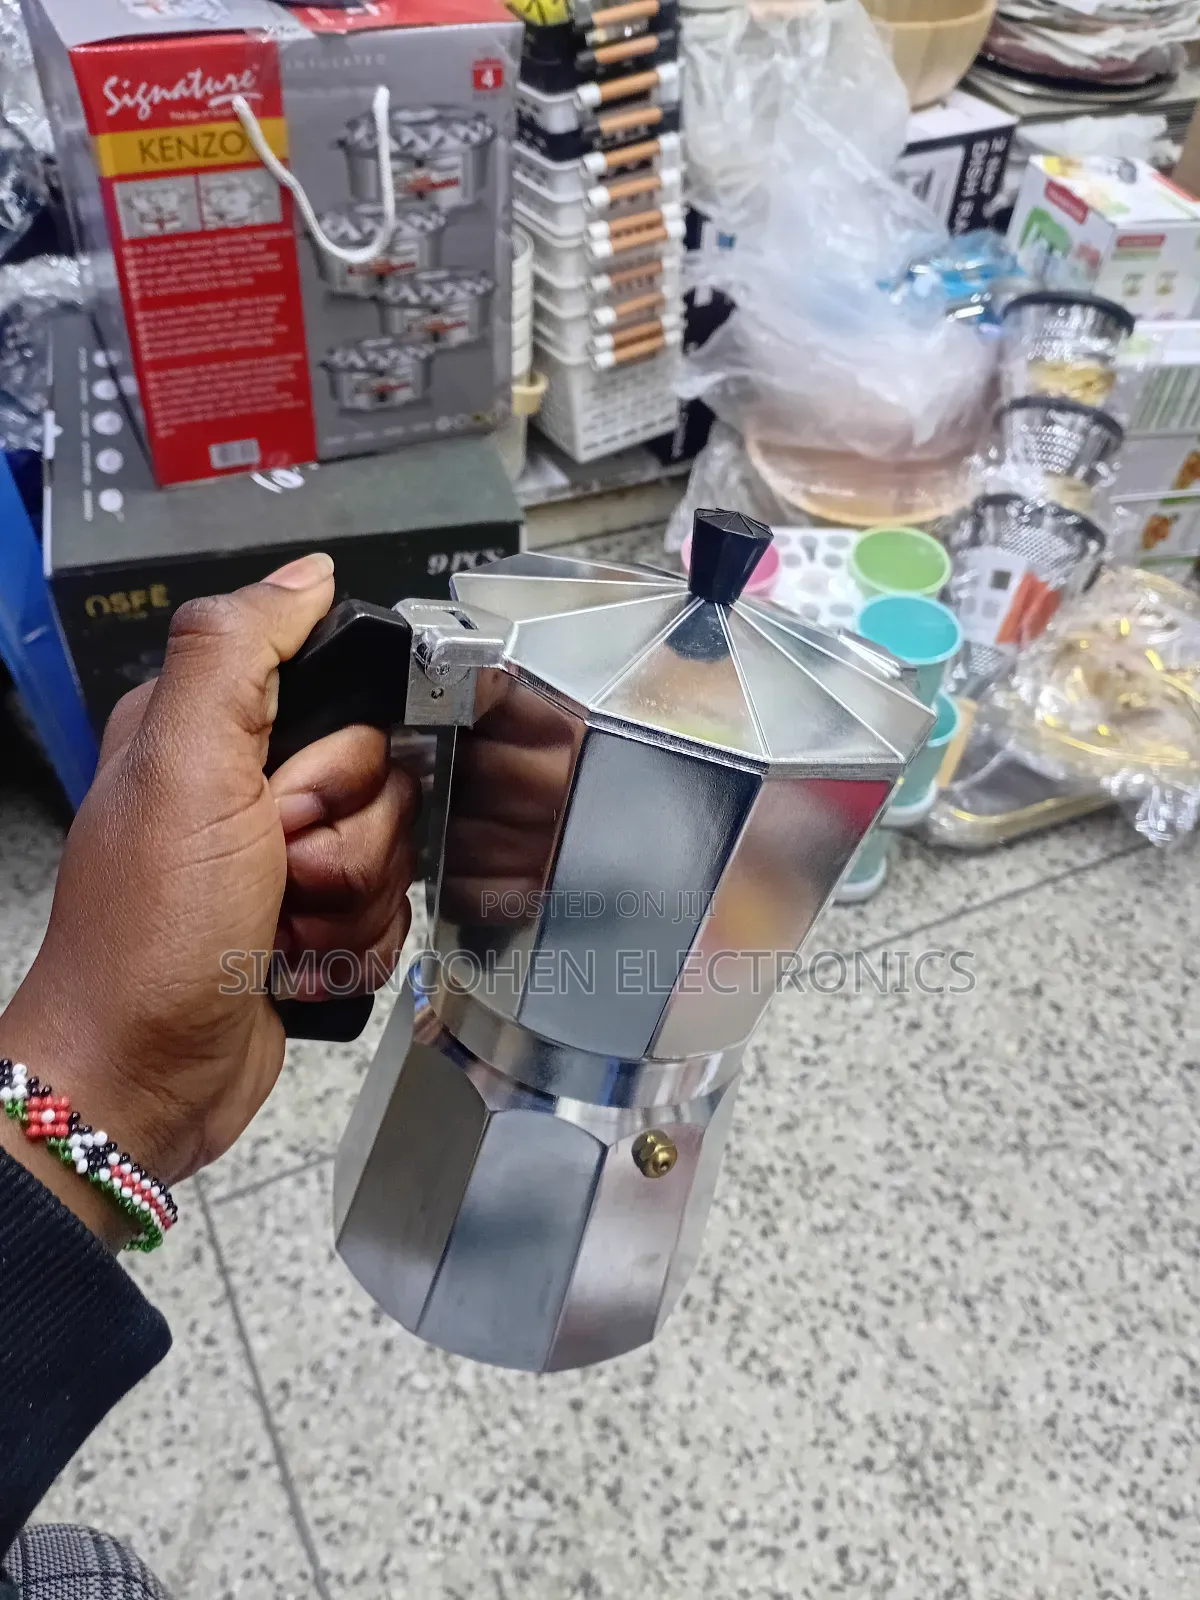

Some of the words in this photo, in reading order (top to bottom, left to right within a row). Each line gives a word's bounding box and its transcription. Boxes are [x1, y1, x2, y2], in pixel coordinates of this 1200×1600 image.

[103, 67, 257, 120] Signature
[481, 69, 494, 88] 4
[138, 130, 247, 164] KENZO
